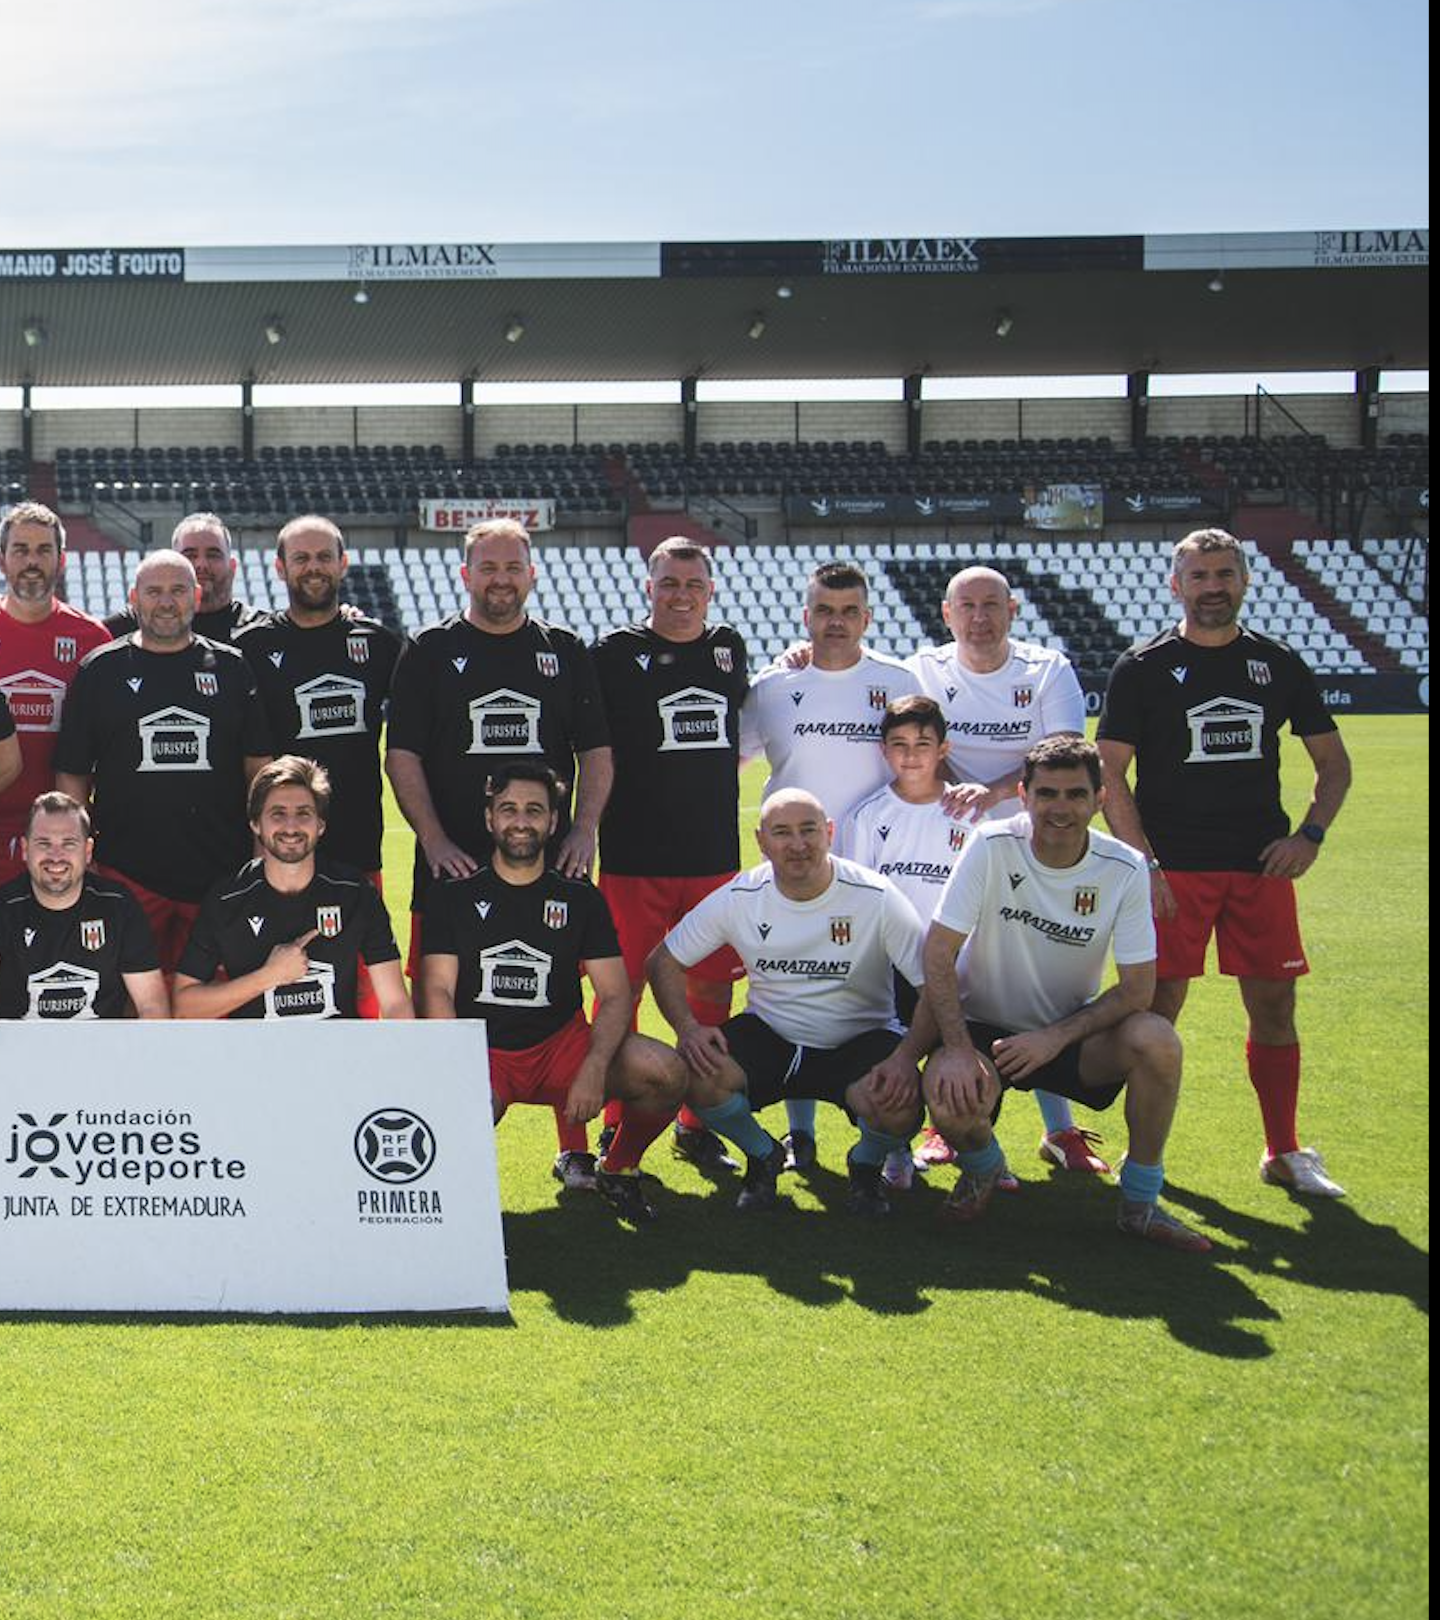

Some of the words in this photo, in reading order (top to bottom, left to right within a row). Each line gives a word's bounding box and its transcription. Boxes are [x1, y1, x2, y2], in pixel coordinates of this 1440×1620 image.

[823, 239, 979, 263] FILMAEX
[1314, 231, 1428, 254] FILMA
[62, 250, 113, 276] JOSÉ
[118, 252, 182, 275] FOUTO
[347, 244, 497, 267] FILMAEX
[793, 722, 884, 736] RARATRAN
[1000, 906, 1096, 943] RARATRANS
[755, 958, 852, 975] RARATRANS
[76, 1110, 192, 1126] fundación
[75, 1157, 247, 1186] ydeporte
[3, 1195, 60, 1220] JUNTA
[71, 1195, 94, 1217] DE
[103, 1195, 247, 1218] EXTREMADURA
[357, 1190, 442, 1214] PRIMERA
